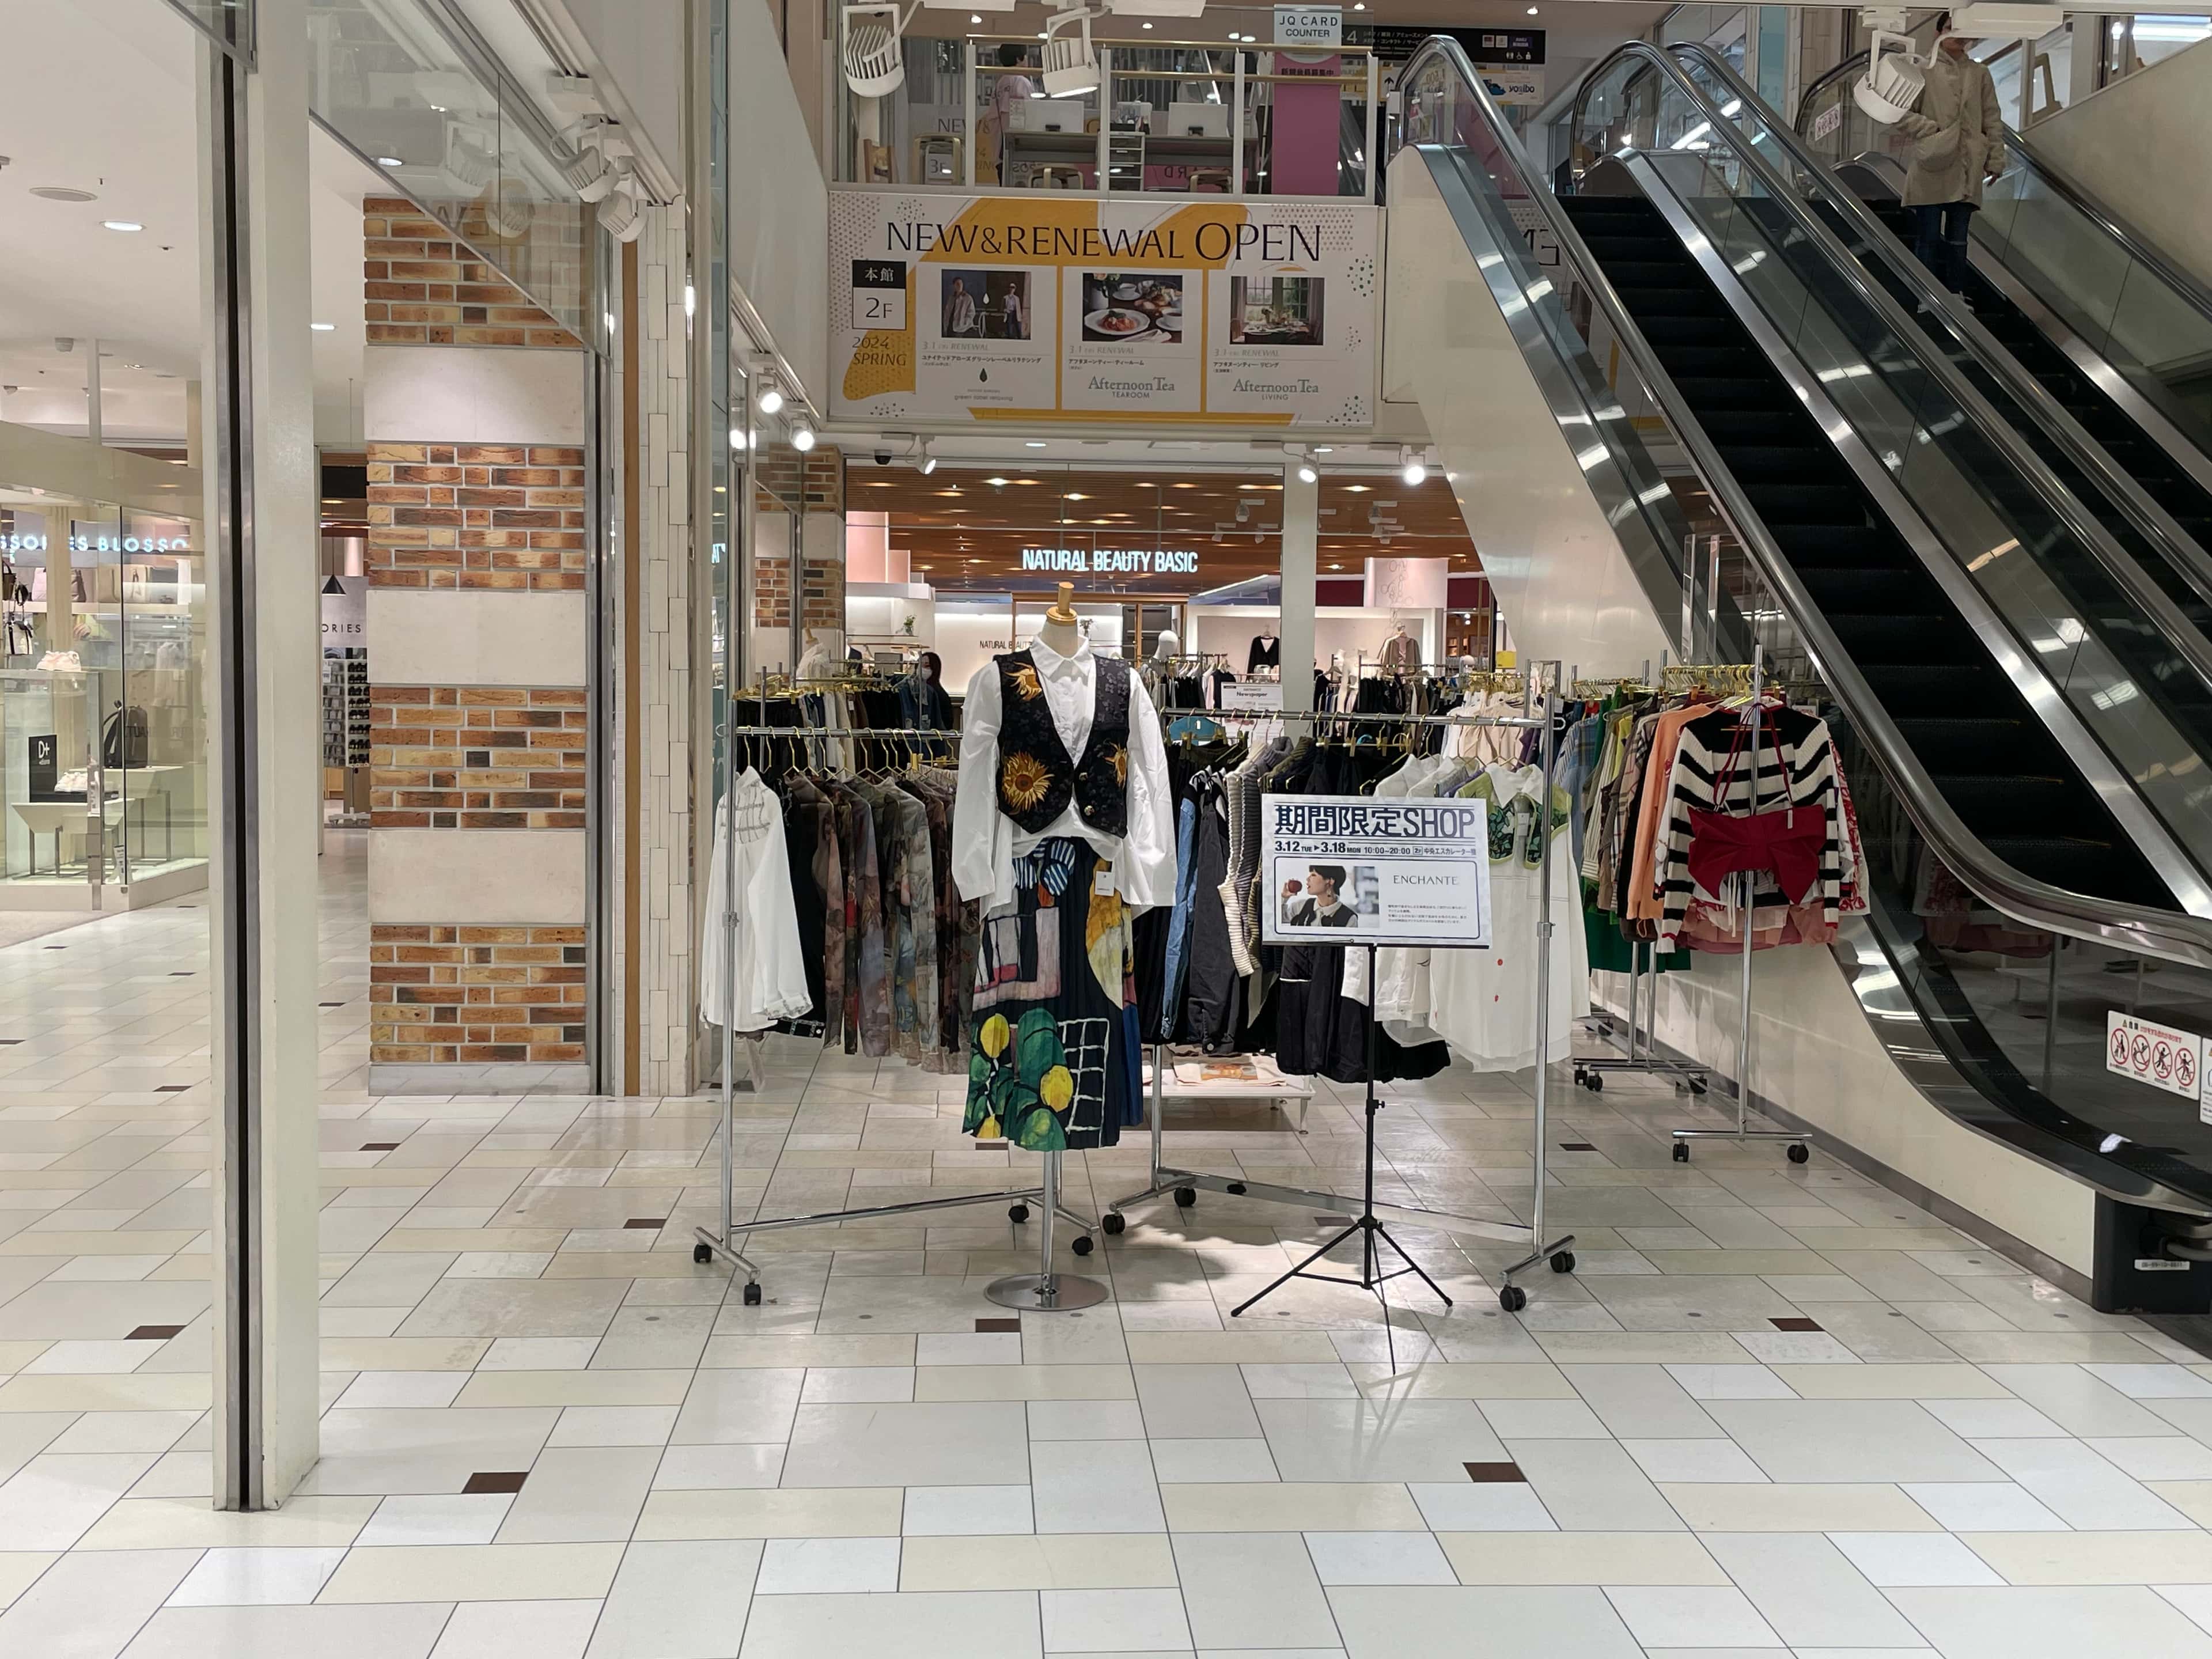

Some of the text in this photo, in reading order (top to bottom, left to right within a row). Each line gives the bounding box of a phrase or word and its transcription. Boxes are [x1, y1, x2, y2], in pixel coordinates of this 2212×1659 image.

[1279, 16, 1338, 26] JQ CARD
[1286, 29, 1330, 37] COUNTER
[887, 222, 1321, 262] NEW&RENEWAL OPEN
[865, 267, 894, 282] 本館
[866, 297, 893, 319] 2F
[852, 336, 890, 350] 2024
[853, 353, 907, 366] SPRING
[1088, 375, 1175, 391] Afternoon Tea
[1233, 378, 1319, 393] Afternoon Tea
[1022, 549, 1198, 573] NATURAL BEAUTY BASIC
[321, 624, 361, 633] ORIES
[980, 641, 1006, 649] NATURAL
[1275, 806, 1475, 839] 期間限定SHOP
[1275, 840, 1300, 852] 3.12
[1320, 842, 1346, 853] 3.18
[1393, 875, 1459, 885] ENCHANTE
